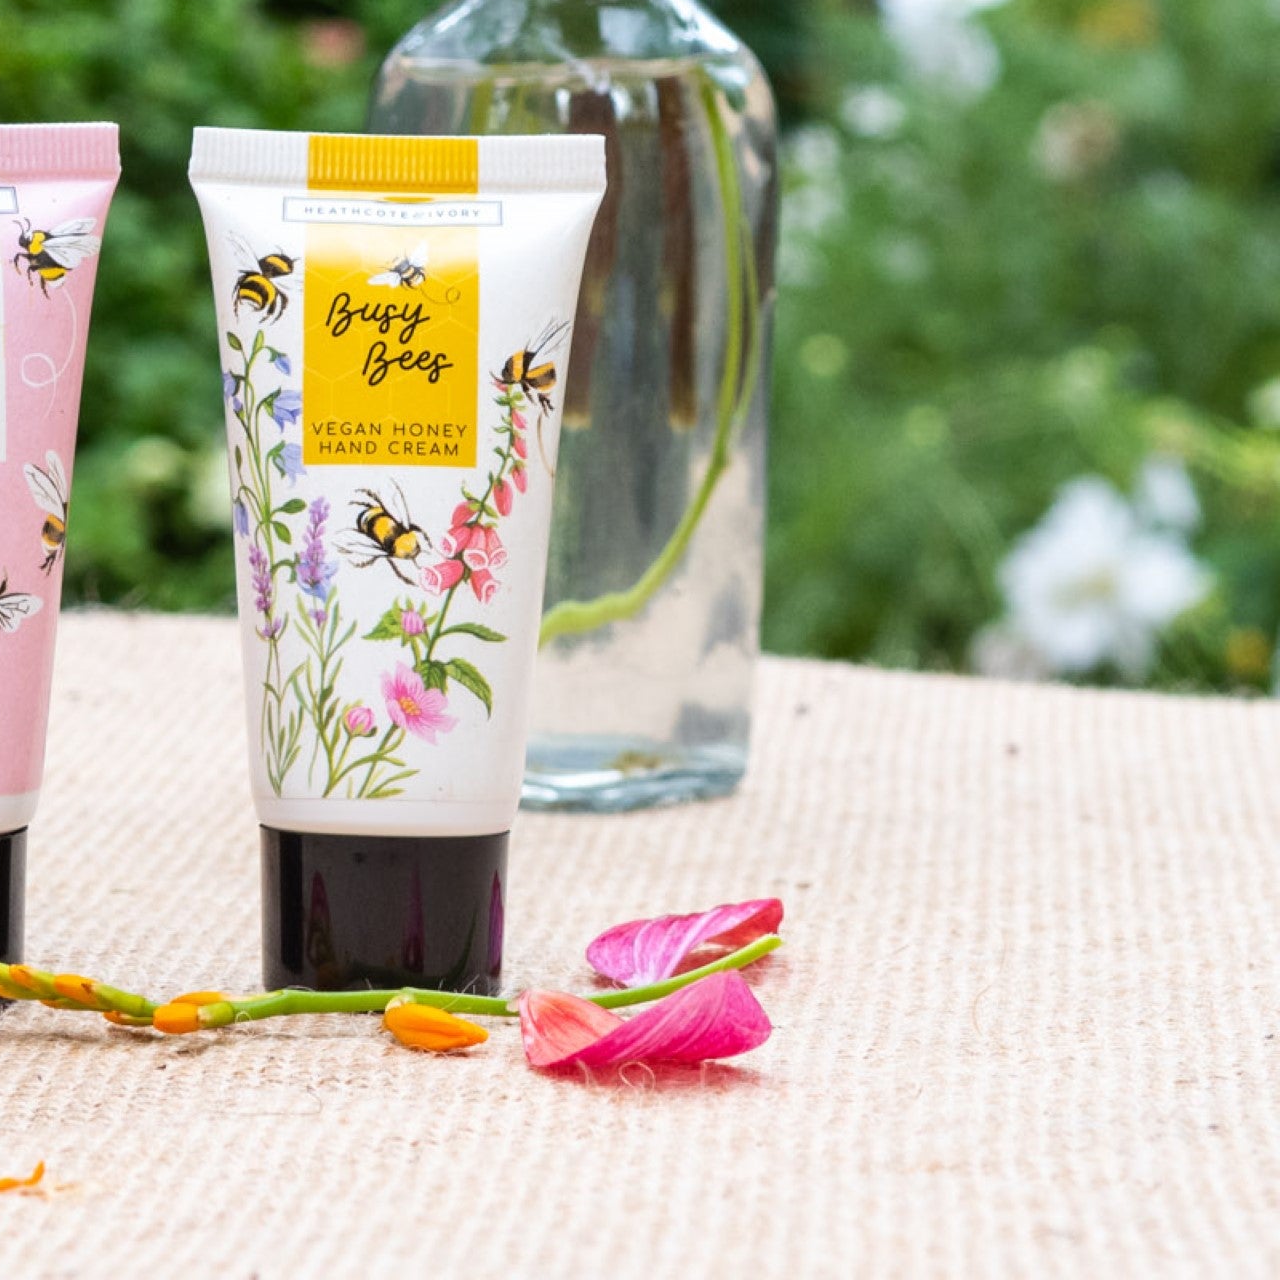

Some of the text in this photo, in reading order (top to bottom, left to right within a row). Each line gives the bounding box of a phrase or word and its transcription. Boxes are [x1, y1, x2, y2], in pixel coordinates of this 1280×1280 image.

[326, 292, 430, 344] Busy
[362, 341, 454, 386] Bees
[312, 421, 467, 438] VEGAN HONEY
[319, 441, 459, 457] HAND CREAM
